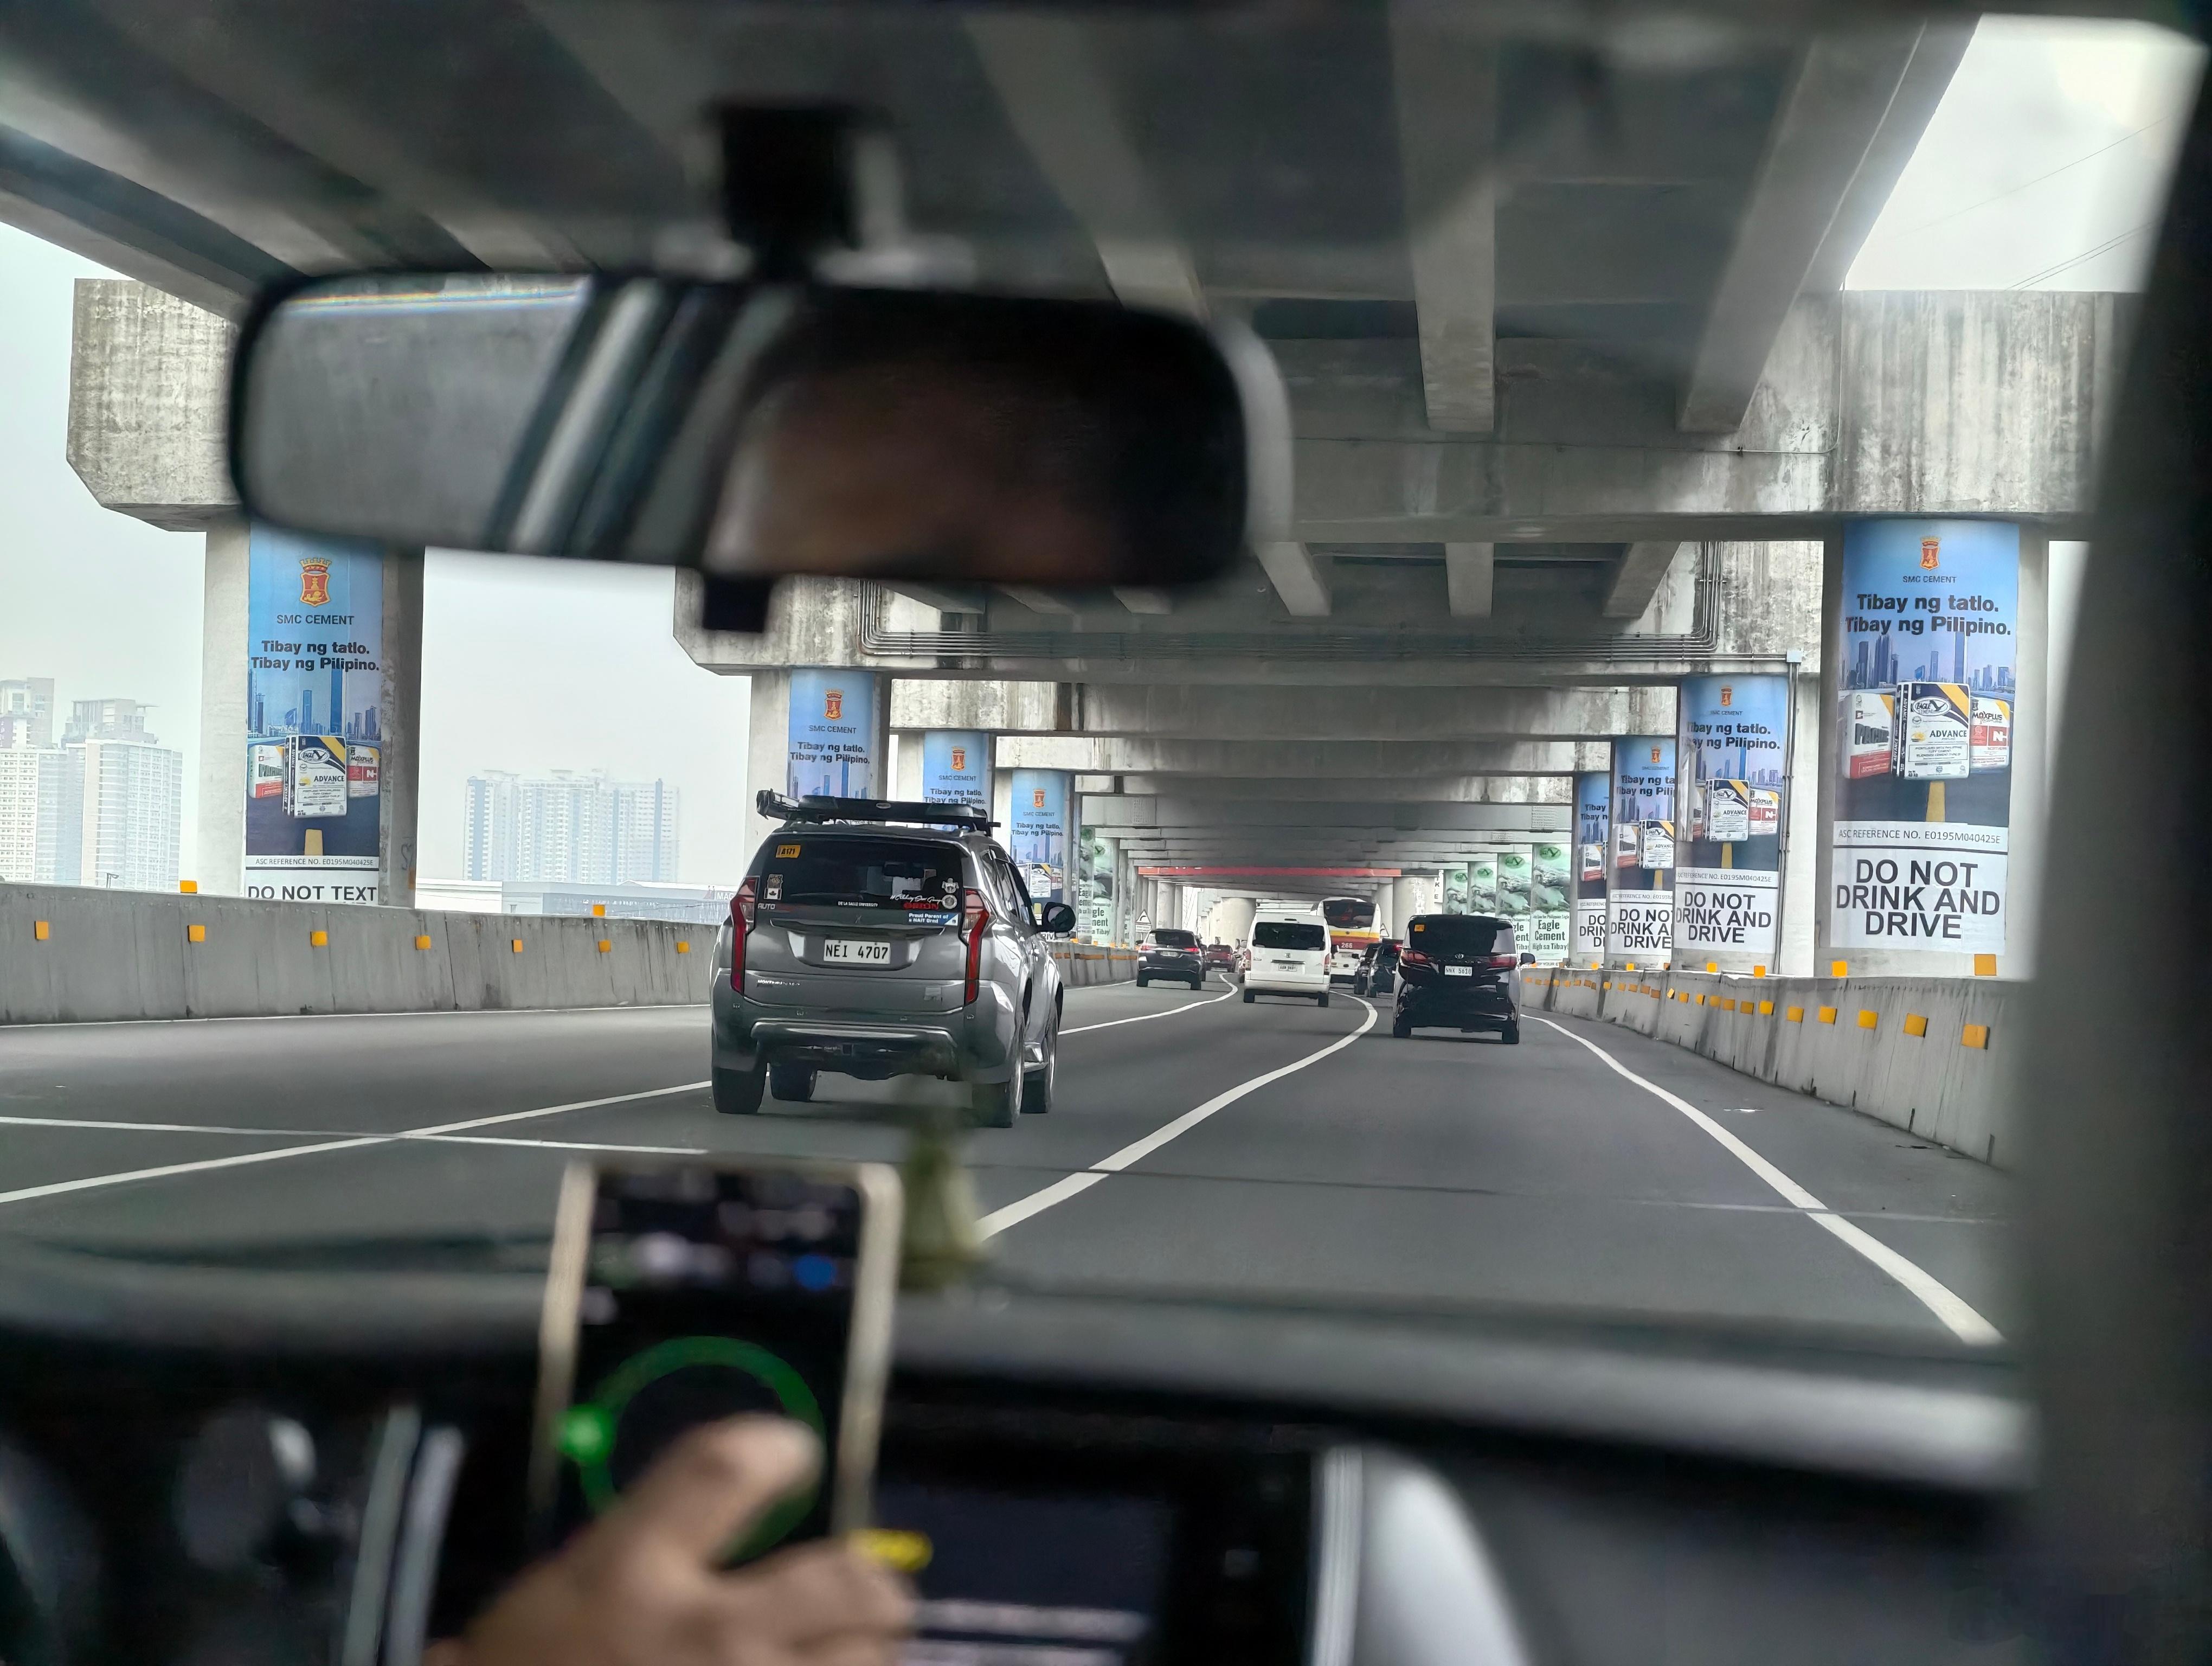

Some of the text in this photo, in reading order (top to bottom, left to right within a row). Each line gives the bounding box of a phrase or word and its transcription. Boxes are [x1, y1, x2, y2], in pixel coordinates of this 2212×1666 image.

[1857, 594, 1998, 613] Tibay ng tatlo.
[277, 614, 355, 625] SMC CEMENT
[1846, 616, 2011, 636] Tibay ng Pilipino.
[262, 640, 370, 655] Tibay ng tatlo.
[251, 657, 379, 672] Tibay ng Pilipino.
[1716, 725, 1732, 735] ng
[1737, 723, 1771, 734] tatlo.
[798, 742, 865, 752] Tibay ng tatlo.
[1707, 739, 1721, 749] ng
[1726, 737, 1779, 749] Pilipino.
[790, 752, 816, 762] Tibay
[836, 754, 870, 764] Pilipino.
[1648, 777, 1661, 785] ng
[1640, 789, 1652, 797] ng
[1839, 829, 2000, 844] ASC REFERENCE NO. E0195M040425E
[1856, 858, 1978, 888] DO NOT
[248, 886, 377, 901] DO NOT TEXT
[1685, 891, 1756, 909] DO NOT
[1836, 885, 2000, 915] DRINK AND
[1589, 914, 1605, 925] DO
[1620, 908, 1640, 921] DO
[1676, 907, 1771, 927] DRINK AND
[1538, 920, 1560, 931] Eagle
[1611, 922, 1653, 935] DRINK
[1866, 911, 1962, 939] DRIVE
[1535, 931, 1565, 940] Cement
[1689, 925, 1745, 943] DRIVE
[1624, 935, 1671, 949] DRIVE
[826, 944, 889, 959] NEI 4707
